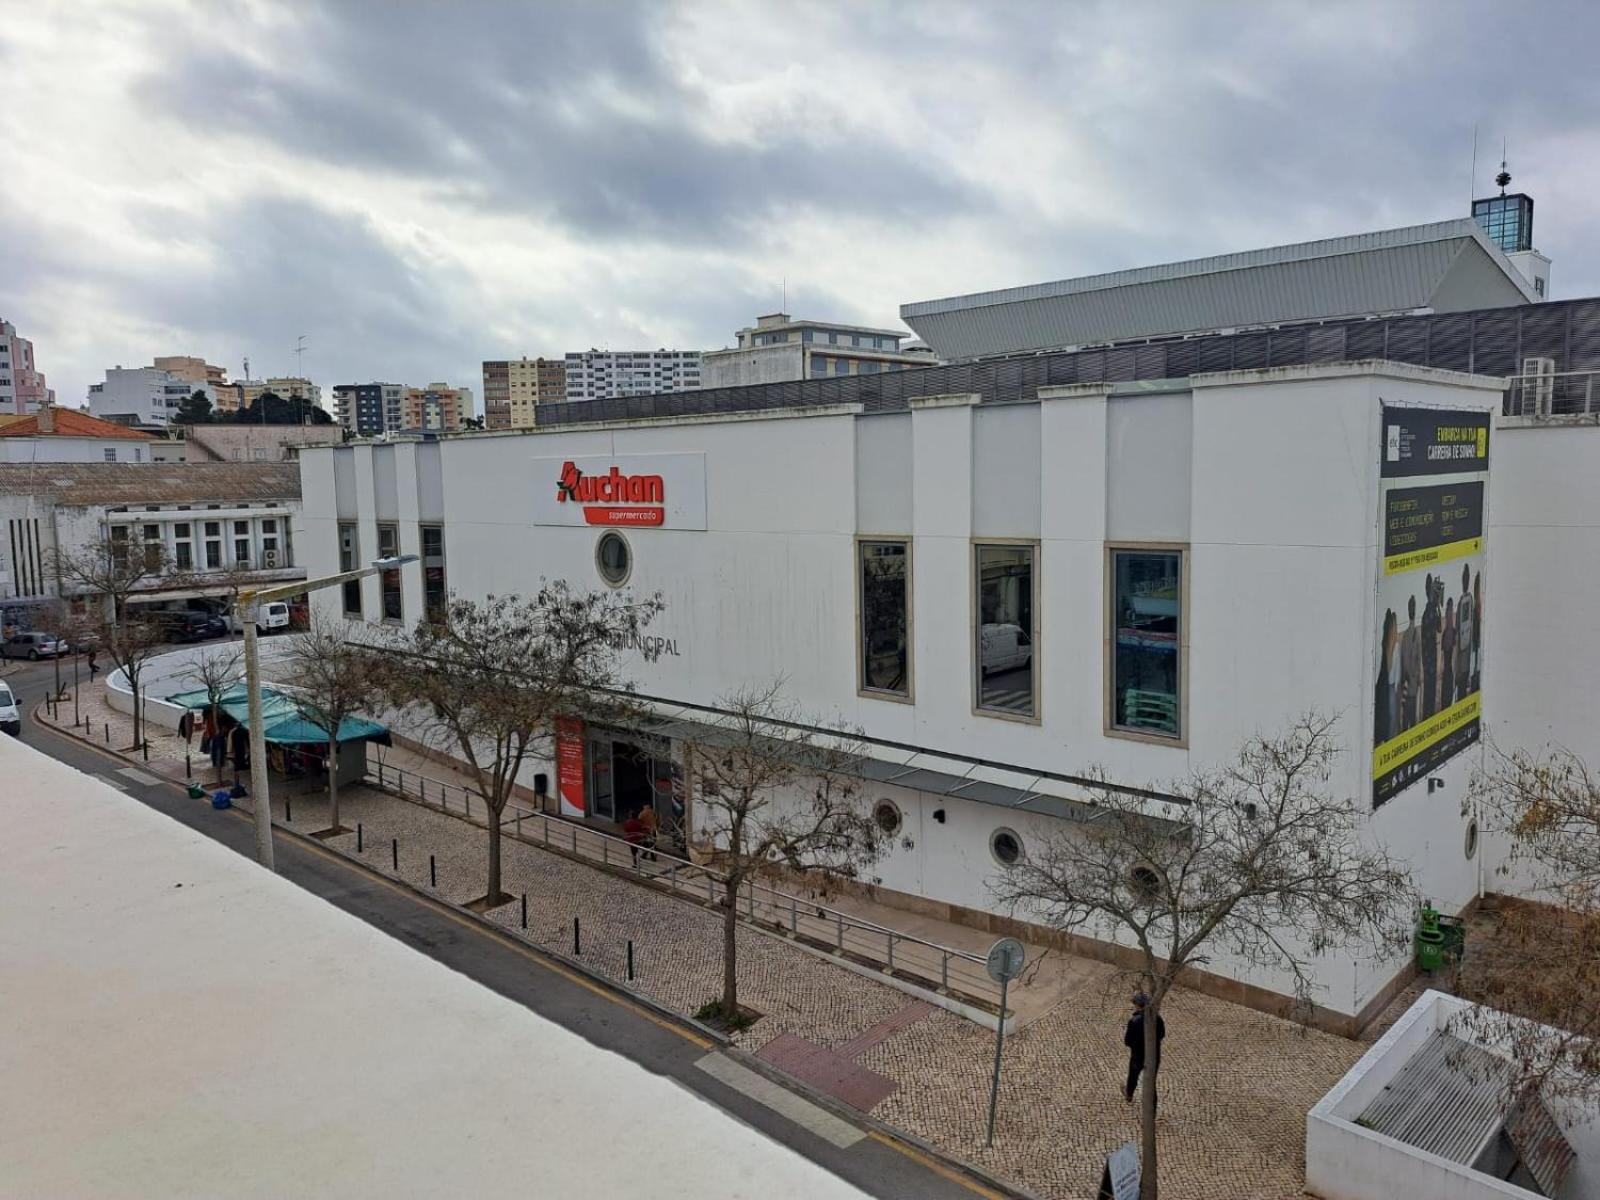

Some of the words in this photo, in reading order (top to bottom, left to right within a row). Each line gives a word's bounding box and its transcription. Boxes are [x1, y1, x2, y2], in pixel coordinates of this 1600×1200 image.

[1427, 445, 1452, 460] CARREIRA
[1453, 444, 1459, 459] DE
[556, 461, 665, 503] Auchan
[608, 511, 657, 521] supermercado
